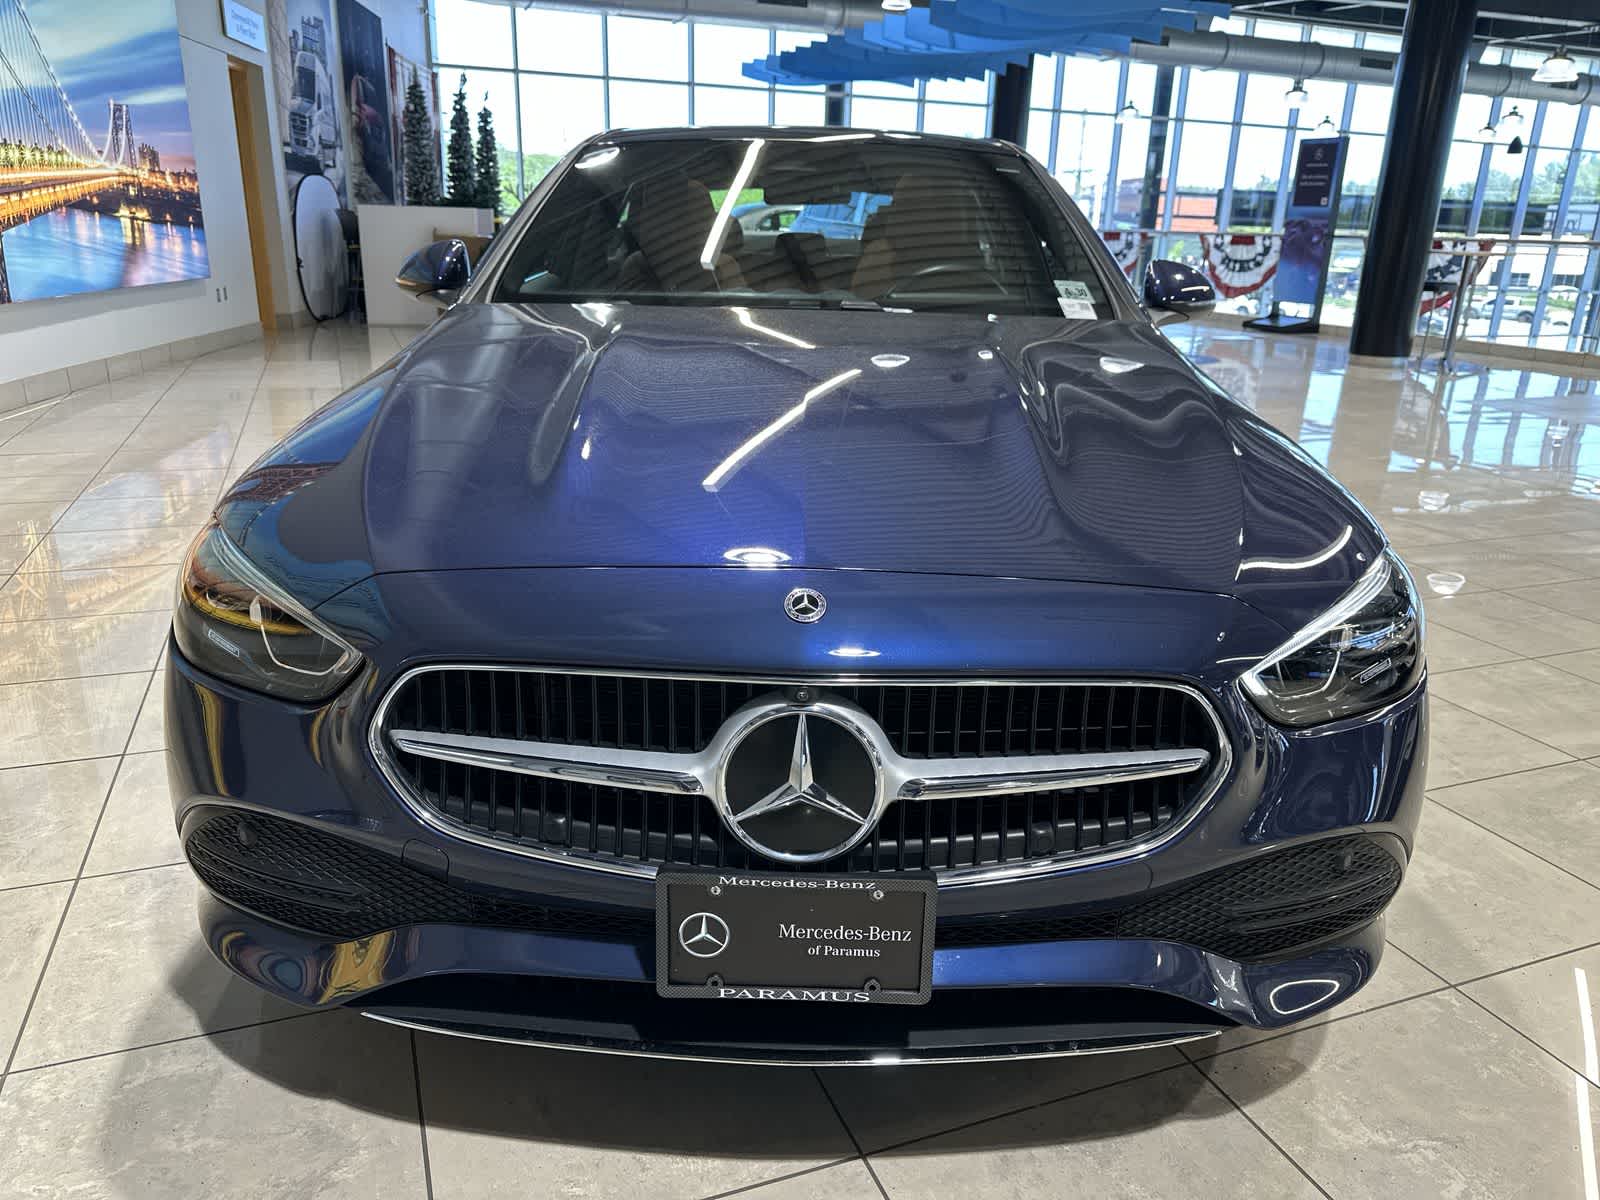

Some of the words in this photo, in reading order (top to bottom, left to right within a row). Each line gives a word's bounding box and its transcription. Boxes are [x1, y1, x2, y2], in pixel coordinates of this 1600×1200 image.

[719, 875, 877, 890] Mercedes-Benz
[778, 923, 912, 942] Mercedes-Benz
[807, 945, 822, 957] of
[824, 945, 881, 958] Paramus
[718, 988, 870, 1003] PARAMUS
